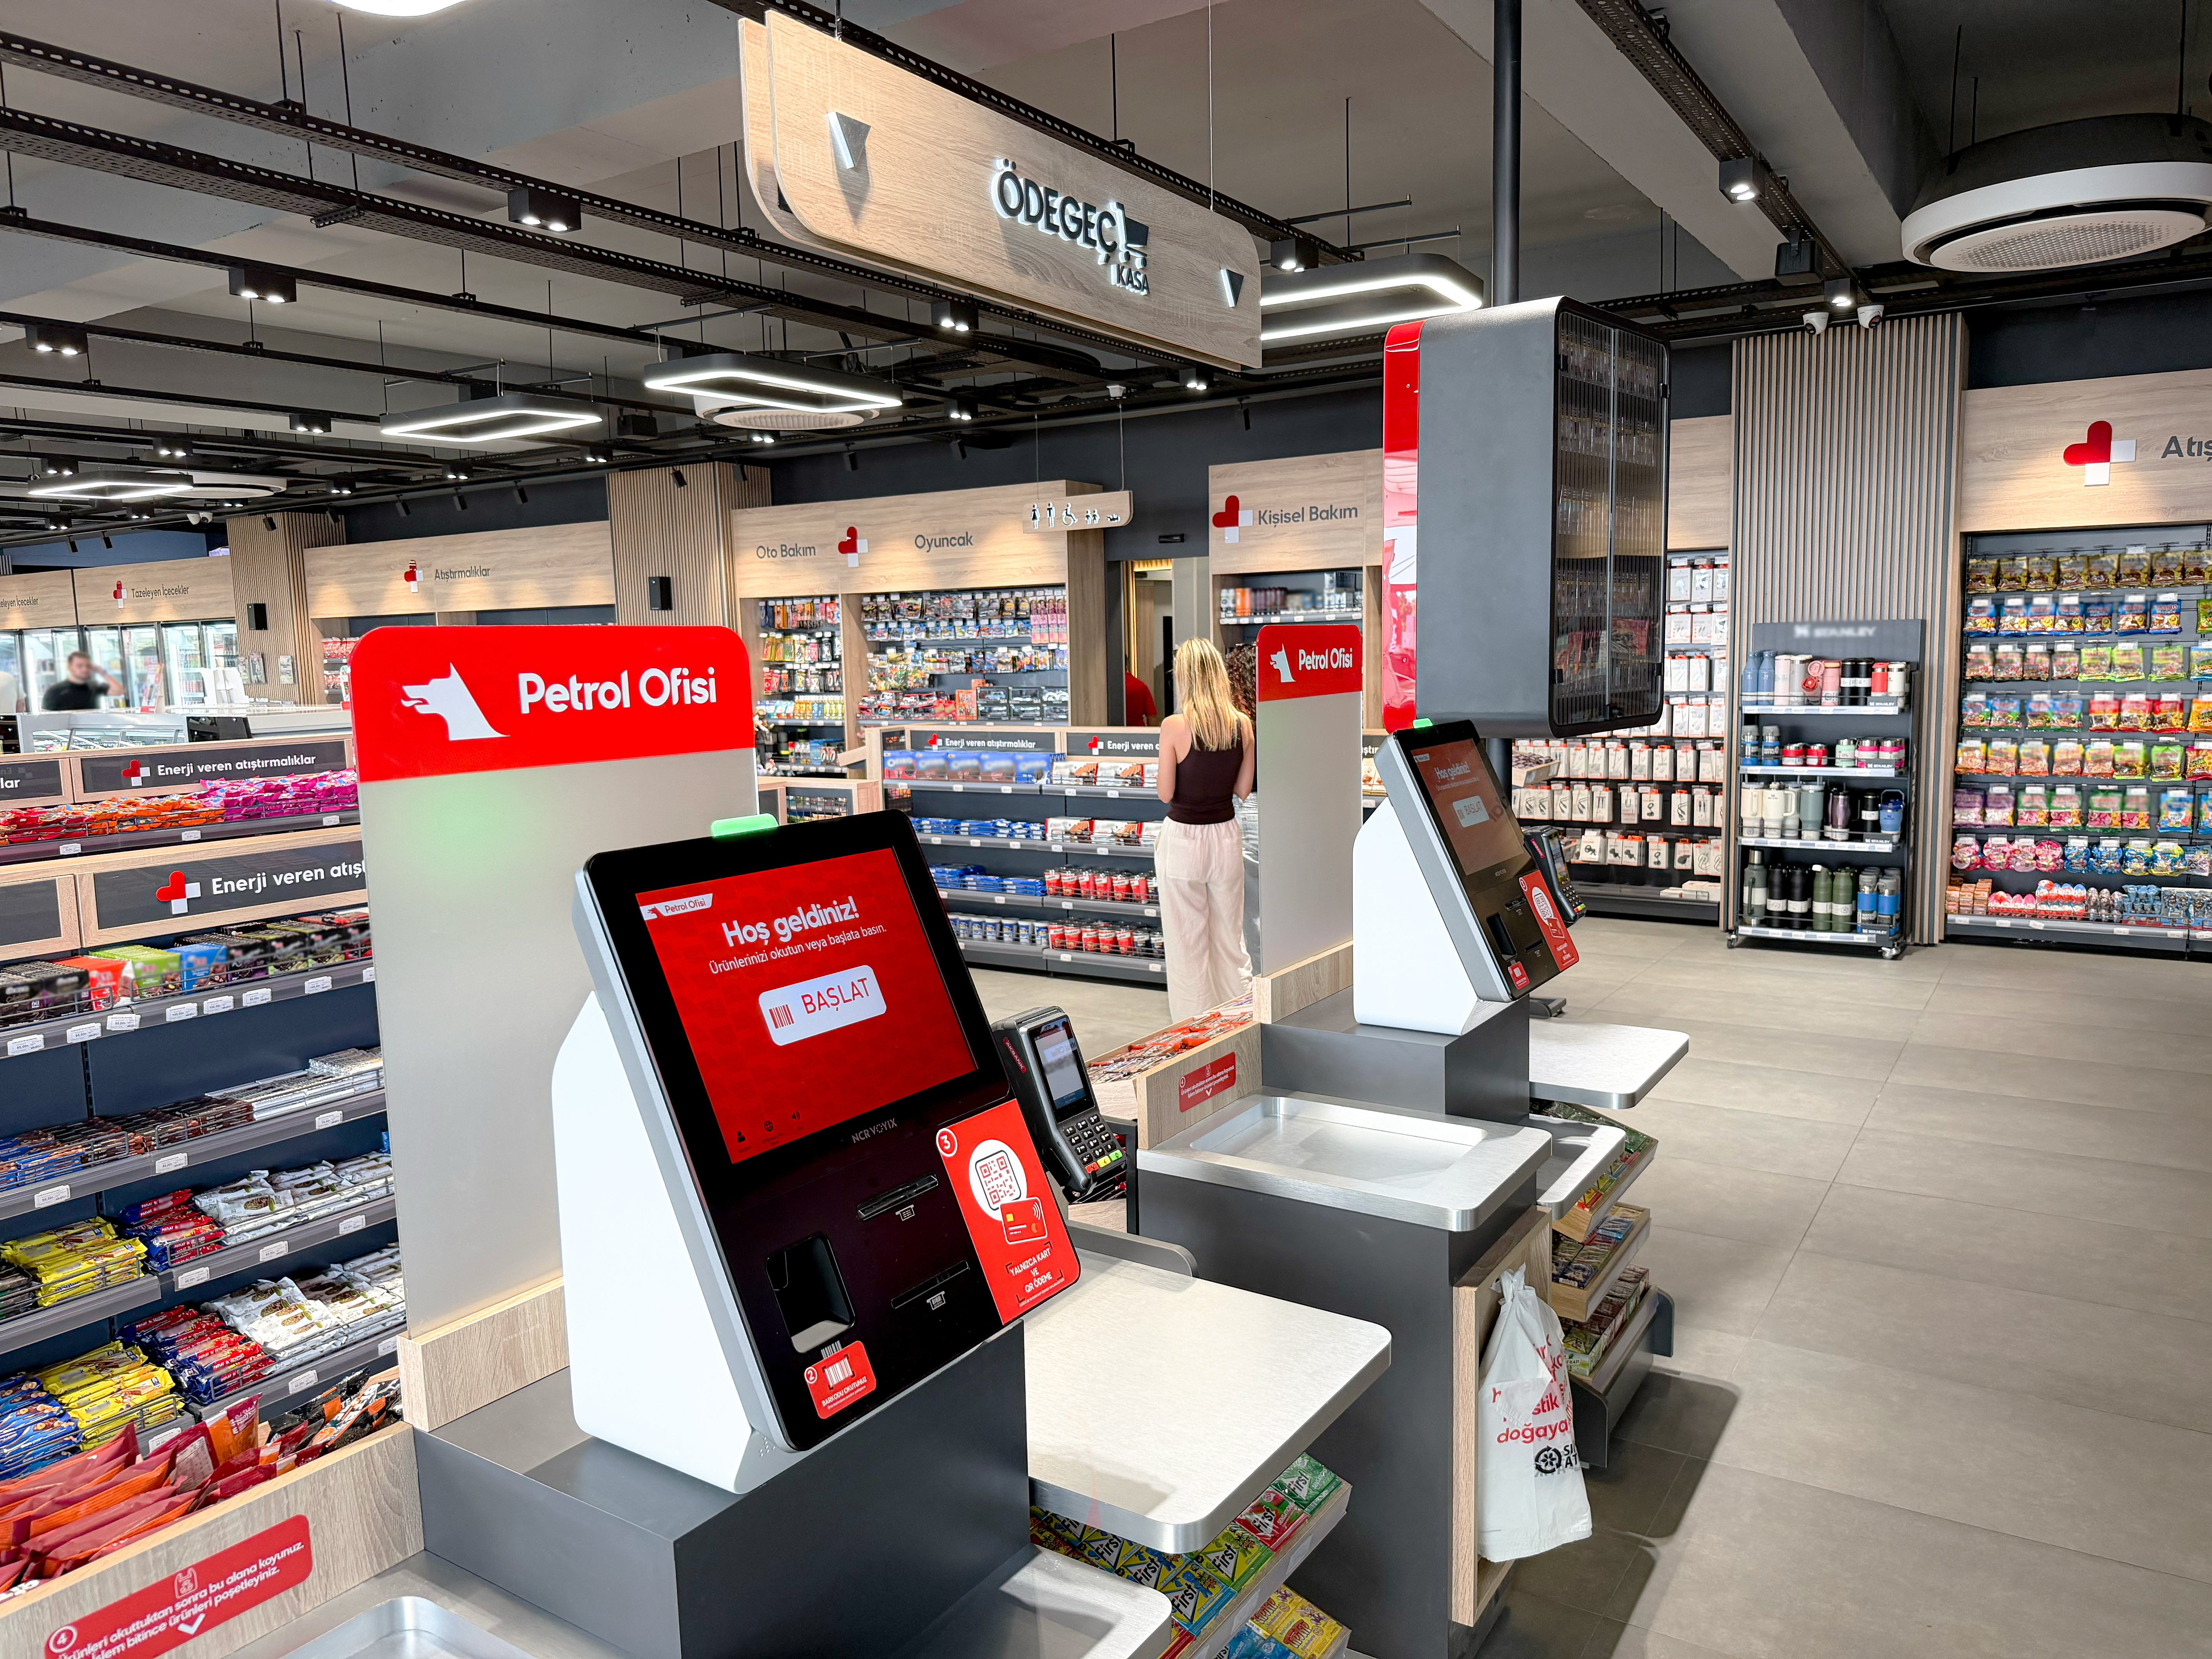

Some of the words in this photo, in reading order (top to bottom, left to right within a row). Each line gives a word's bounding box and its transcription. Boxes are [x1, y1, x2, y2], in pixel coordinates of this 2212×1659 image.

[992, 158, 1118, 265] ÖDEGEÇ
[1111, 263, 1150, 295] KASA
[2161, 436, 2212, 462] Atış
[1259, 507, 1304, 528] Kişisel
[1309, 505, 1358, 522] Bakım
[756, 545, 777, 559] Oto
[780, 543, 816, 558] Bakım
[914, 532, 974, 553] Oyuncak
[434, 565, 491, 582] Atıştırmalıklar
[0, 597, 16, 610] eleyen
[16, 595, 38, 607] İçecekler
[131, 587, 161, 599] Tazeleyen
[162, 584, 189, 598] İçecekler
[1299, 648, 1328, 671] Petrol
[1330, 647, 1353, 669] Ofisi
[518, 670, 631, 714] Petrol
[639, 666, 716, 706] Ofisi
[945, 738, 965, 748] Enerji
[987, 738, 1036, 749] atıştırmalıklar
[1107, 740, 1130, 751] Enerji
[1131, 742, 1154, 750] veren
[158, 763, 194, 777] Enerji
[197, 761, 232, 774] veren
[235, 754, 316, 771] atıştırmalıklar
[0, 777, 21, 789] lar
[211, 872, 267, 895] Enerji
[273, 867, 325, 886] veren
[665, 902, 688, 914] Petrol
[688, 898, 706, 909] Ofisi
[721, 920, 771, 947] Hoş
[774, 895, 860, 943] geldiniz!
[709, 950, 768, 974] Ürünlerinizi
[770, 942, 805, 960] okutun
[805, 938, 828, 952] veya
[829, 930, 860, 946] başlata
[860, 923, 887, 936] basın.
[800, 977, 871, 1014] BAŞLAT
[1005, 1041, 1024, 1069] AKBANK
[852, 1129, 871, 1144] NCR
[869, 1118, 898, 1135] VOYIX
[940, 1135, 951, 1149] 3
[1010, 1254, 1037, 1276] YALNIZCA
[1037, 1247, 1051, 1263] KART
[1030, 1266, 1039, 1275] VE
[1025, 1281, 1034, 1293] QR
[1034, 1271, 1053, 1288] ÖDEME
[807, 1370, 815, 1381] 2
[821, 1389, 844, 1407] BARKODU
[843, 1376, 867, 1394] OKUTUNUZ
[1497, 1419, 1568, 1444] doğaya
[1287, 1470, 1309, 1495] First
[1251, 1505, 1277, 1532] First
[1095, 1535, 1122, 1562] First
[1211, 1543, 1238, 1570] First
[174, 1588, 208, 1611] sonra
[208, 1580, 225, 1594] bu
[225, 1563, 258, 1585] alana
[258, 1541, 305, 1570] koyunuz.
[1133, 1556, 1161, 1585] First
[126, 1622, 167, 1649] bitince
[168, 1597, 213, 1627] ürünleri
[213, 1565, 280, 1607] poşetleyiniz.
[1172, 1582, 1198, 1614] First
[57, 1632, 68, 1645] 4
